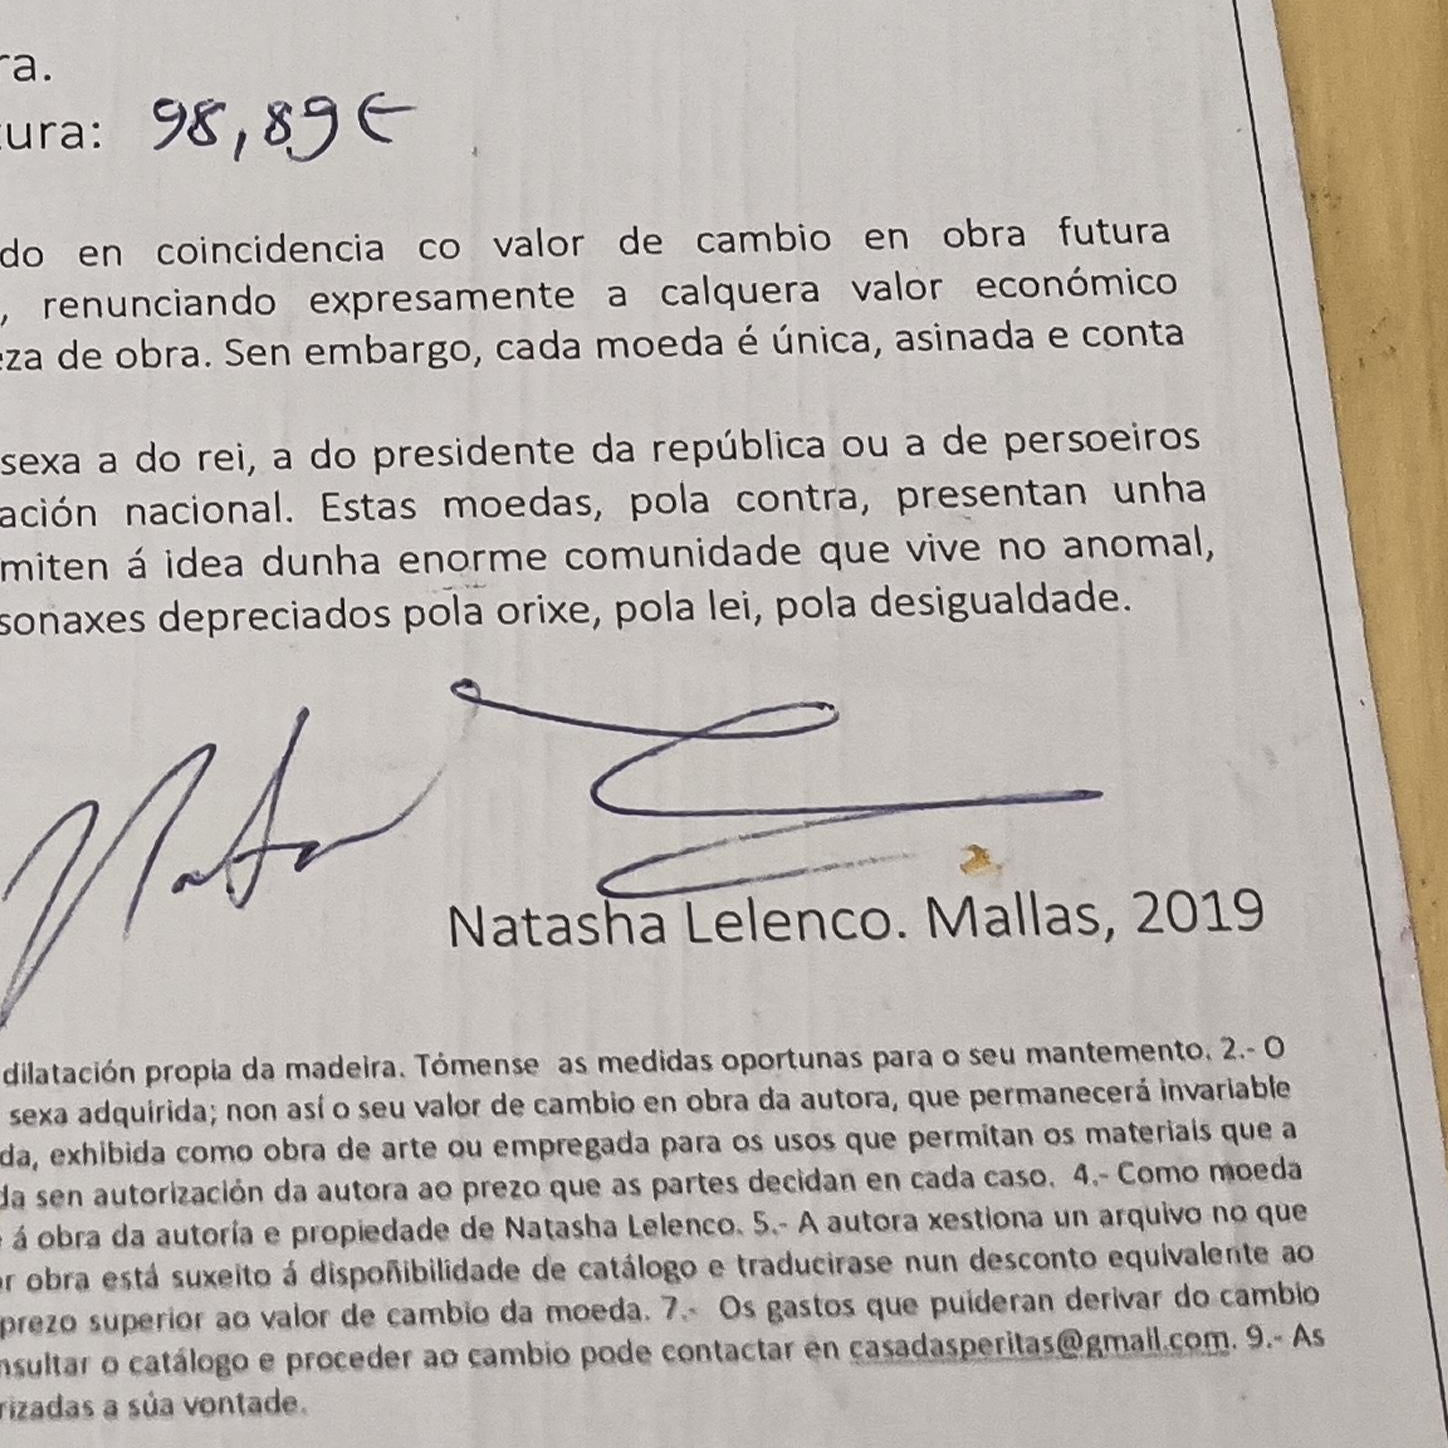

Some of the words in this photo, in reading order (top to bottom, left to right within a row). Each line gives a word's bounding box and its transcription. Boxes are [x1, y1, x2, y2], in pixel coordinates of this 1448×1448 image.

[77, 243, 122, 267] en
[156, 231, 384, 266] coincidencia
[418, 237, 461, 261] co
[491, 225, 585, 258] valor
[618, 223, 663, 256] de
[695, 221, 832, 254] cambio
[863, 227, 909, 251] en
[942, 216, 1026, 248] obra
[1057, 214, 1170, 246] futura
[43, 281, 276, 320] renunciando
[308, 281, 575, 321] expresamente
[606, 285, 627, 308] a
[660, 273, 820, 312] calquera
[850, 269, 943, 302] valor
[975, 264, 1178, 299] económico
[56, 338, 103, 370] de
[114, 336, 212, 369] obra.
[224, 337, 291, 367] Sen
[304, 332, 482, 370] embargo,
[495, 328, 581, 361] cada
[595, 324, 724, 360] moeda
[737, 322, 759, 356] é
[771, 322, 882, 360] única,
[894, 317, 1034, 352] asinada
[1047, 325, 1069, 349] e
[1081, 319, 1184, 347] conta
[0, 451, 80, 476] sexa
[97, 451, 119, 475] a
[134, 439, 181, 473] do
[197, 441, 256, 478] rei,
[272, 447, 292, 470] a
[309, 436, 356, 470] do
[373, 433, 575, 476] presidente
[591, 430, 635, 465] da
[652, 426, 827, 470] república
[841, 434, 888, 458] ou
[904, 433, 925, 457] a
[941, 422, 988, 456] de
[1003, 420, 1201, 461] persoeiros
[125, 488, 293, 526] nacional.
[320, 491, 417, 523] Estas
[443, 483, 602, 523] moedas,
[629, 478, 710, 522] pola
[735, 482, 869, 517] contra,
[895, 478, 1087, 512] presentan
[1112, 469, 1206, 505] unha
[127, 545, 147, 579] á
[163, 544, 243, 579] idea
[261, 542, 380, 577] dunha
[398, 547, 548, 574] enorme
[564, 533, 801, 571] comunidade
[818, 540, 890, 572] que
[904, 531, 981, 563] vive
[997, 536, 1046, 561] no
[1062, 522, 1214, 563] anomal,
[157, 595, 391, 639] depreciados
[403, 594, 483, 635] pola
[496, 592, 601, 632] orixe,
[614, 588, 694, 631] pola
[707, 587, 762, 627] lei,
[775, 584, 857, 627] pola
[869, 578, 1131, 623] desigualdade.
[447, 898, 666, 948] Natasha
[684, 894, 907, 944] Lelenco.
[925, 888, 1115, 944] Mallas,
[1131, 886, 1264, 934] 2019
[2, 1057, 136, 1087] dilatación
[144, 1057, 231, 1089] propia
[241, 1055, 275, 1082] da
[284, 1053, 406, 1081] madeira.
